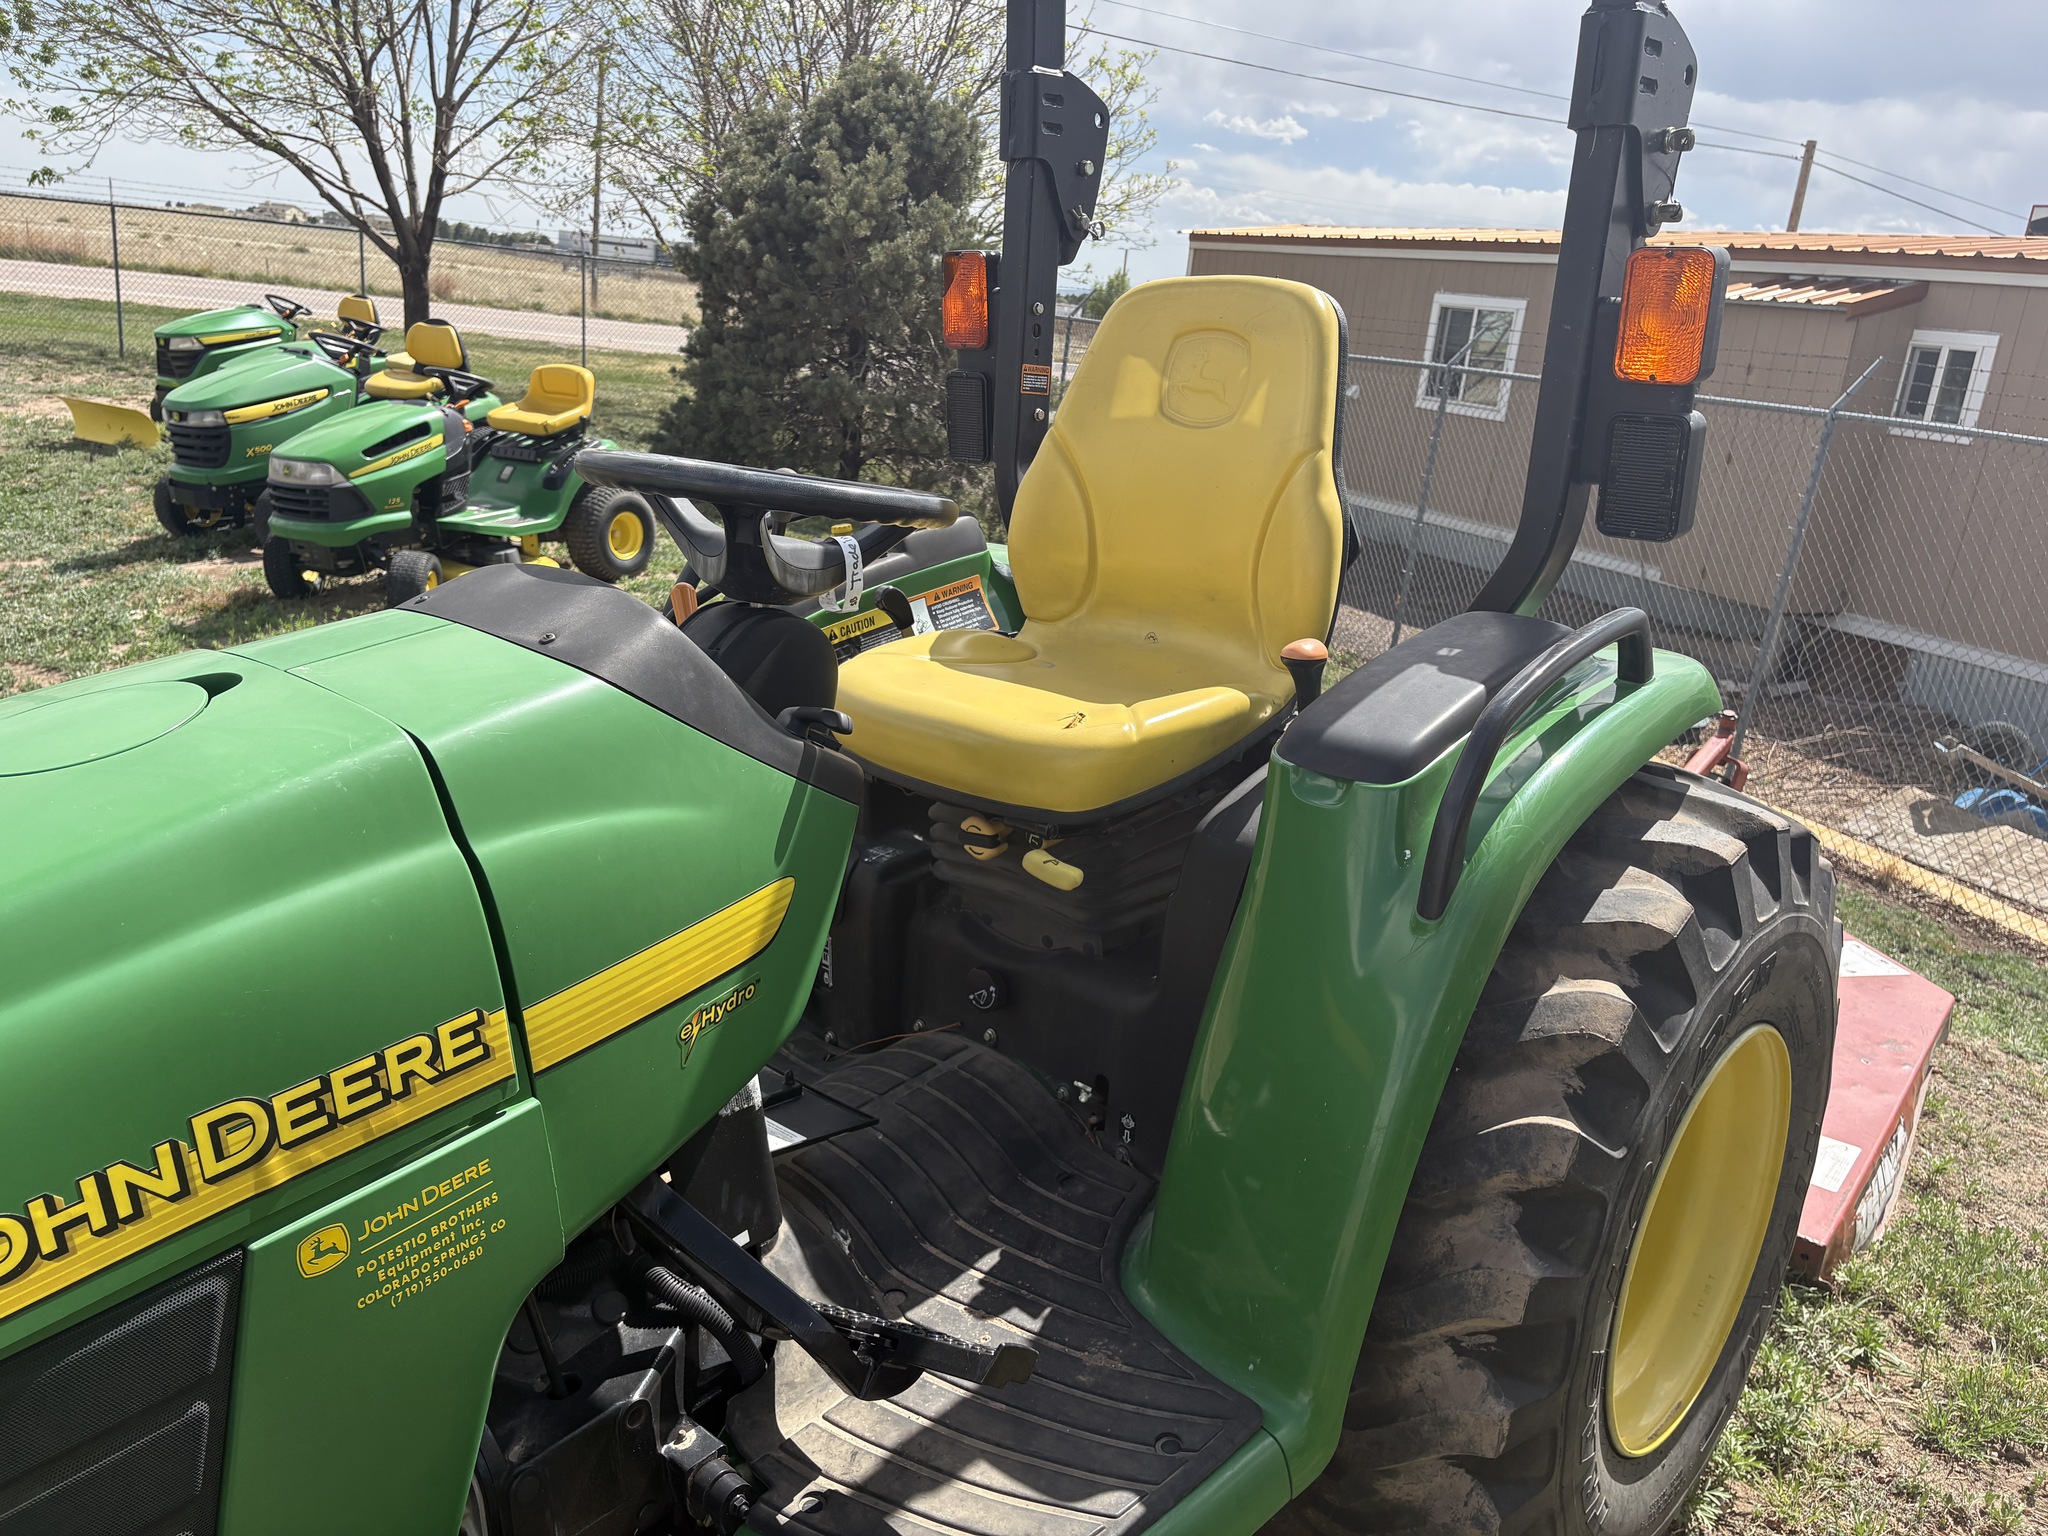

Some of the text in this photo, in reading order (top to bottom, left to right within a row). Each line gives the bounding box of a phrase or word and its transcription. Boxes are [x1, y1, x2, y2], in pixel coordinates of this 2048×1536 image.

[272, 394, 318, 412] JOHN DEERE
[246, 444, 272, 458] X500
[848, 543, 861, 591] Trade
[941, 581, 973, 599] WARNING
[840, 616, 875, 637] CAUTION
[188, 1008, 494, 1185] DEERE
[358, 1158, 491, 1241] JOHN DEERE
[356, 1192, 498, 1278] POTESTIO BROTHERS
[357, 1218, 507, 1309] COLORADO SPRINGS CO
[377, 1219, 485, 1282] Equipment Inc.
[390, 1246, 483, 1308] (719)550-0680
